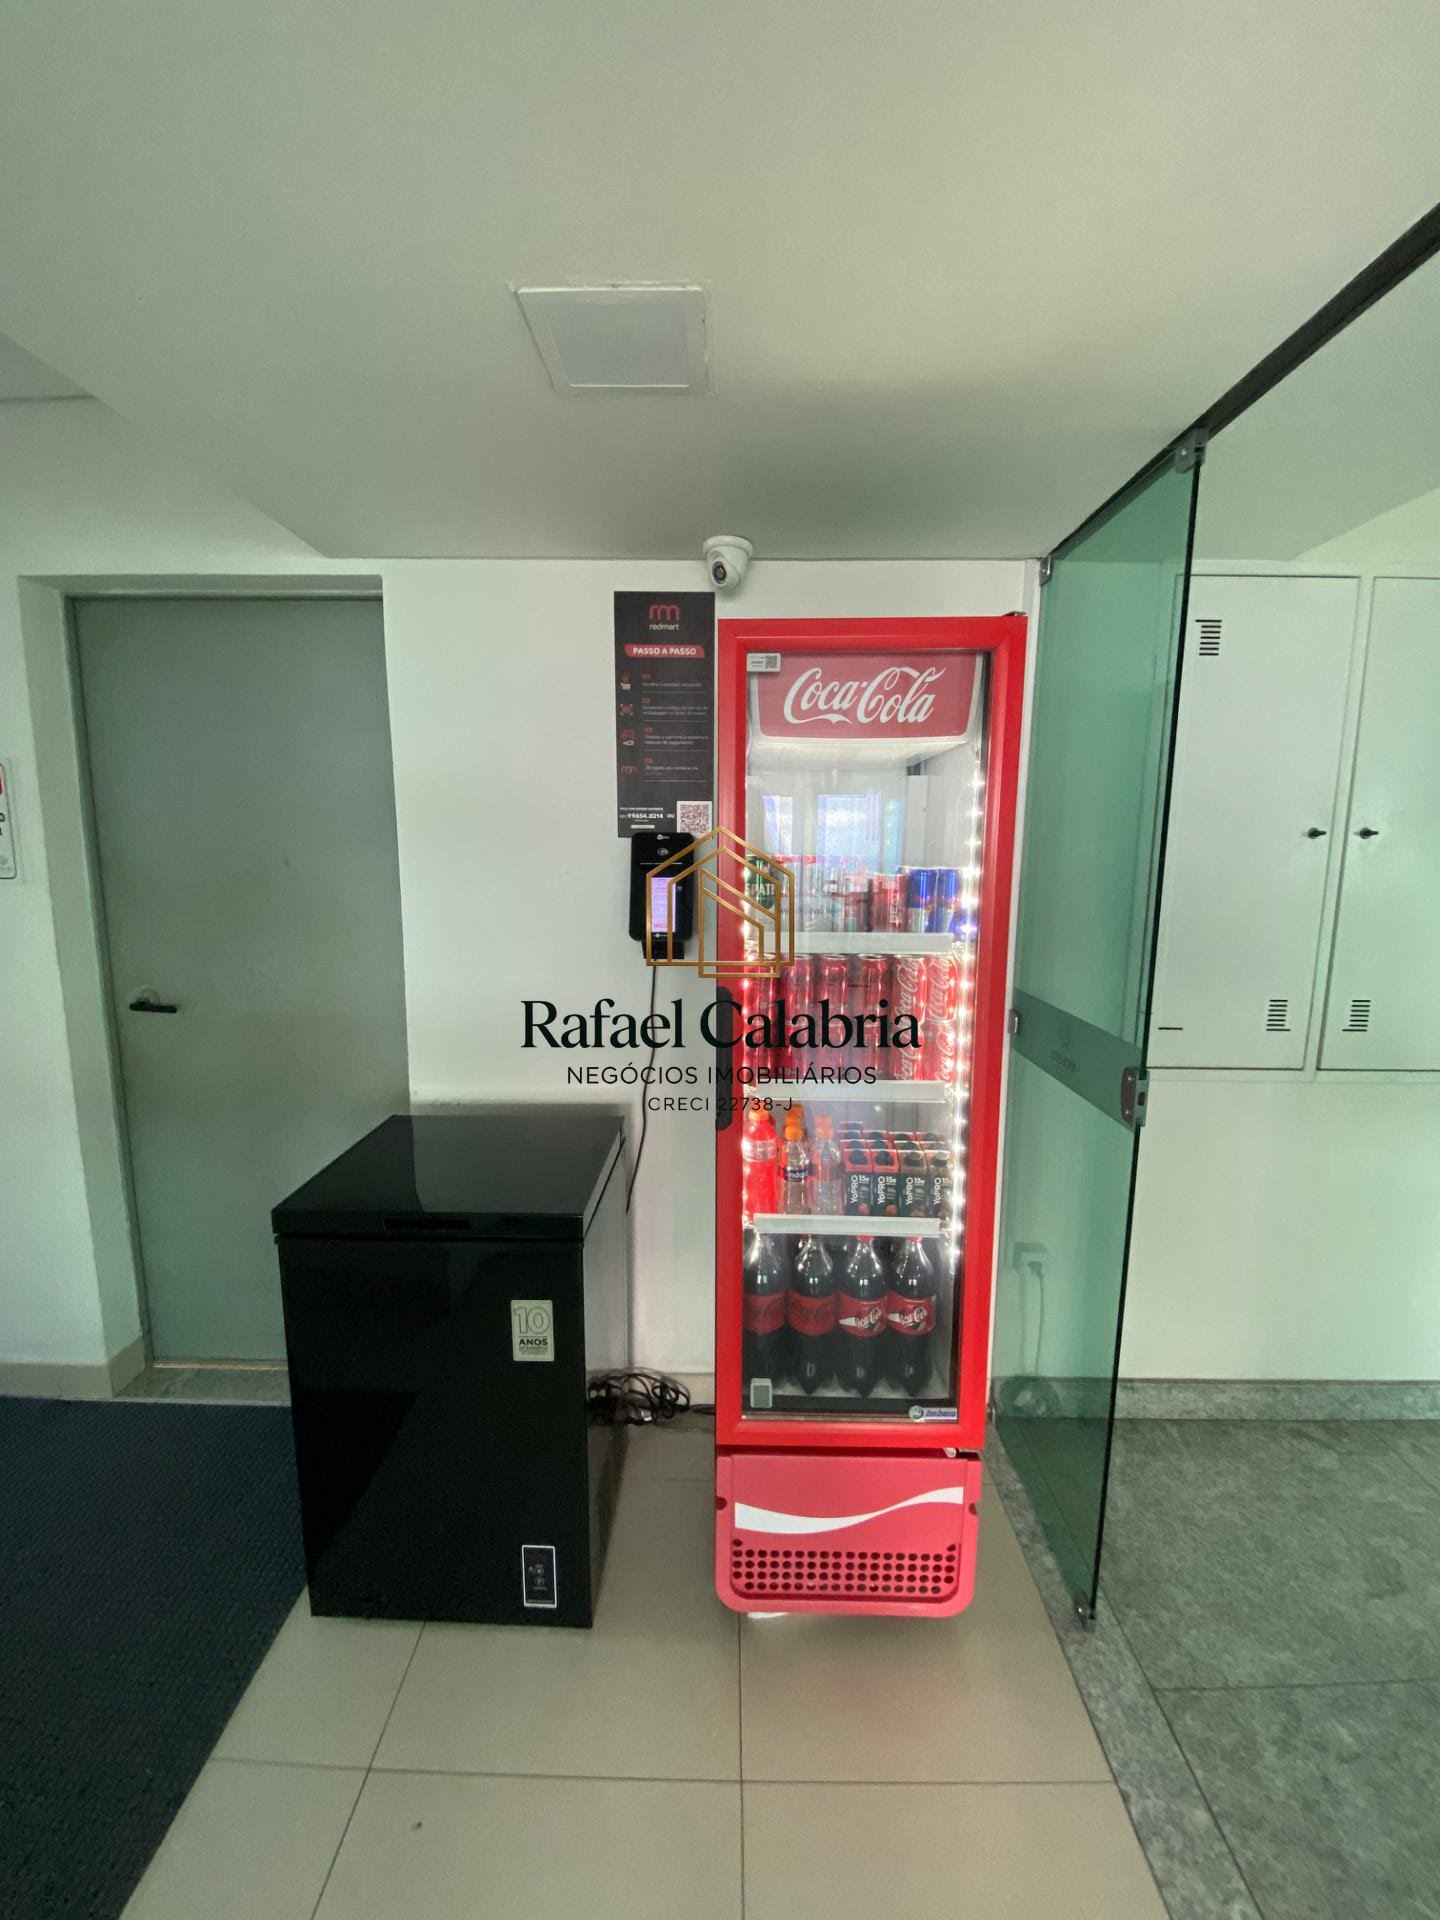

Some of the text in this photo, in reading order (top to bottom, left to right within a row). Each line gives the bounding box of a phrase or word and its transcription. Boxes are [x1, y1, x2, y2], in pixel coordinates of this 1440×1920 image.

[649, 623, 680, 631] redmart
[633, 647, 697, 655] PASSO A PASSO
[783, 666, 947, 725] Coca-Cola
[850, 1175, 858, 1204] YoPRO
[877, 1176, 886, 1204] YoPRO
[905, 1177, 914, 1205] YoPRO
[933, 1177, 941, 1205] YoPRO
[513, 1306, 551, 1335] 10
[518, 1338, 548, 1346] ANOS
